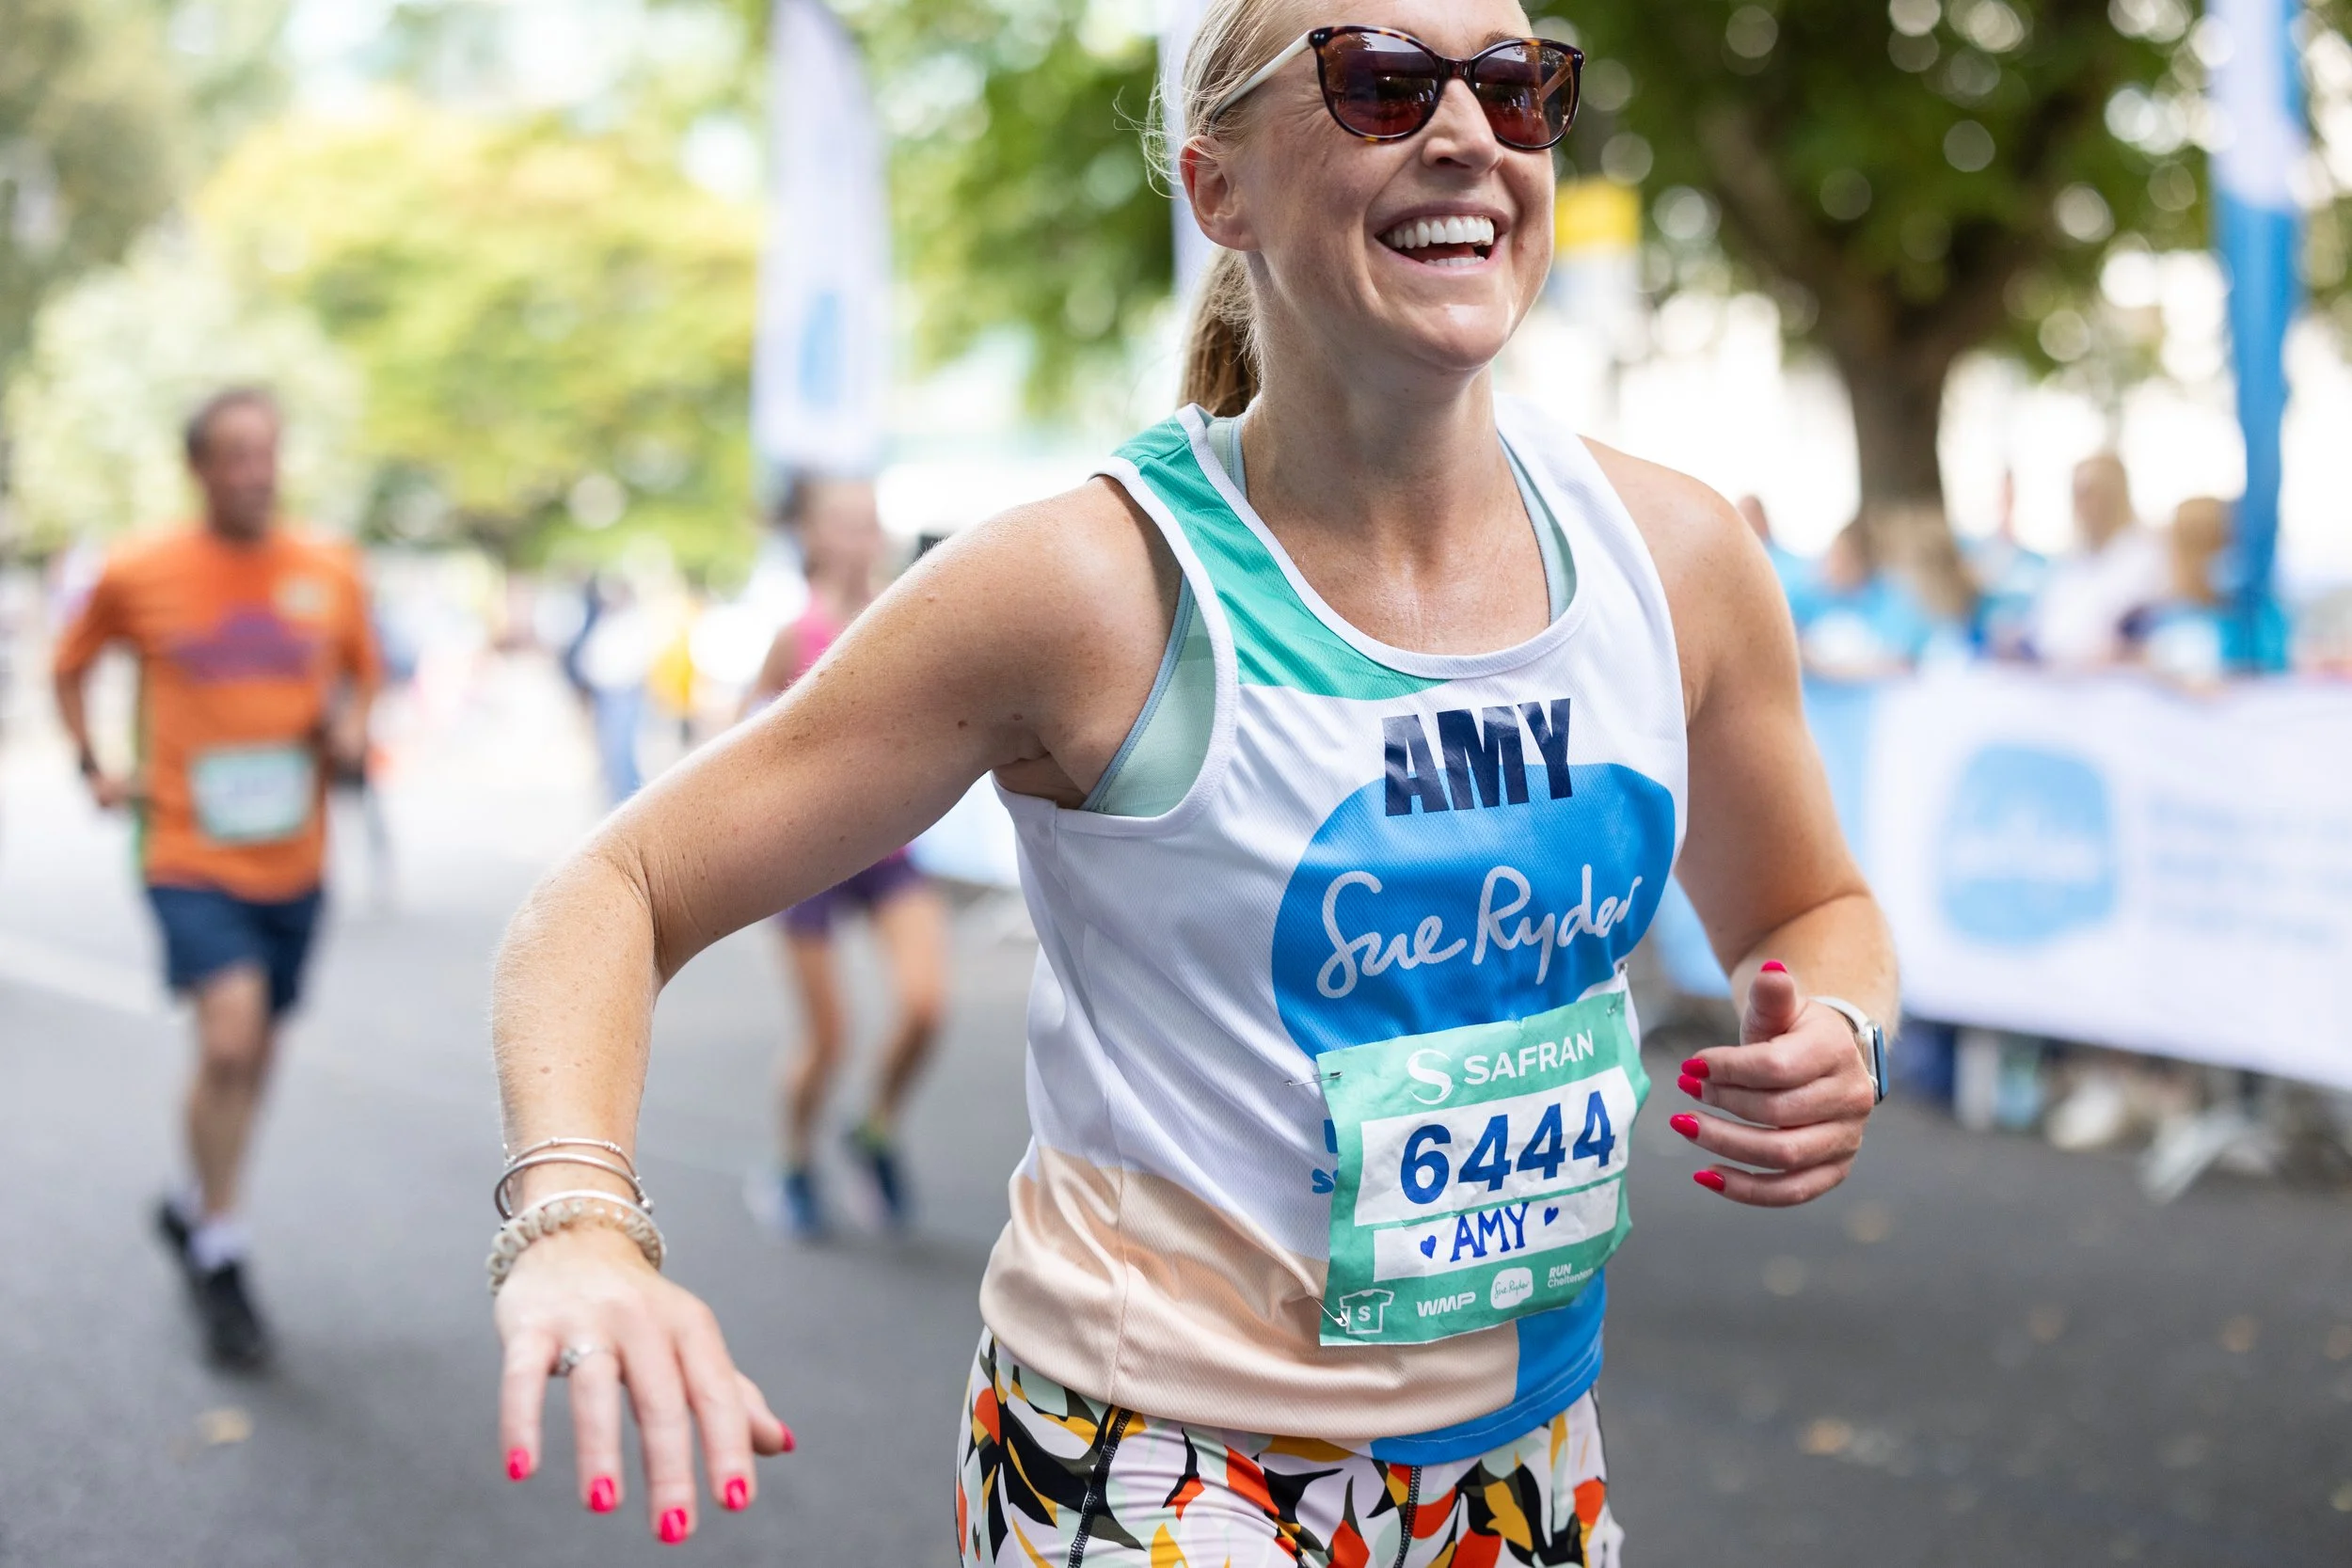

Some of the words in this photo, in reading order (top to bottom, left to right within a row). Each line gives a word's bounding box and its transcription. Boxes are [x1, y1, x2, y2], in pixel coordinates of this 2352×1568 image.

[1382, 698, 1573, 816] AMY
[1317, 871, 1468, 998] Sue
[1471, 864, 1643, 985] Ryder
[1463, 1029, 1594, 1085] SAFRAN
[1400, 1090, 1615, 1205] 6444
[1450, 1201, 1530, 1262] AMY
[1549, 1262, 1572, 1278] RUN
[1358, 1306, 1372, 1322] S
[1416, 1291, 1476, 1317] WMP
